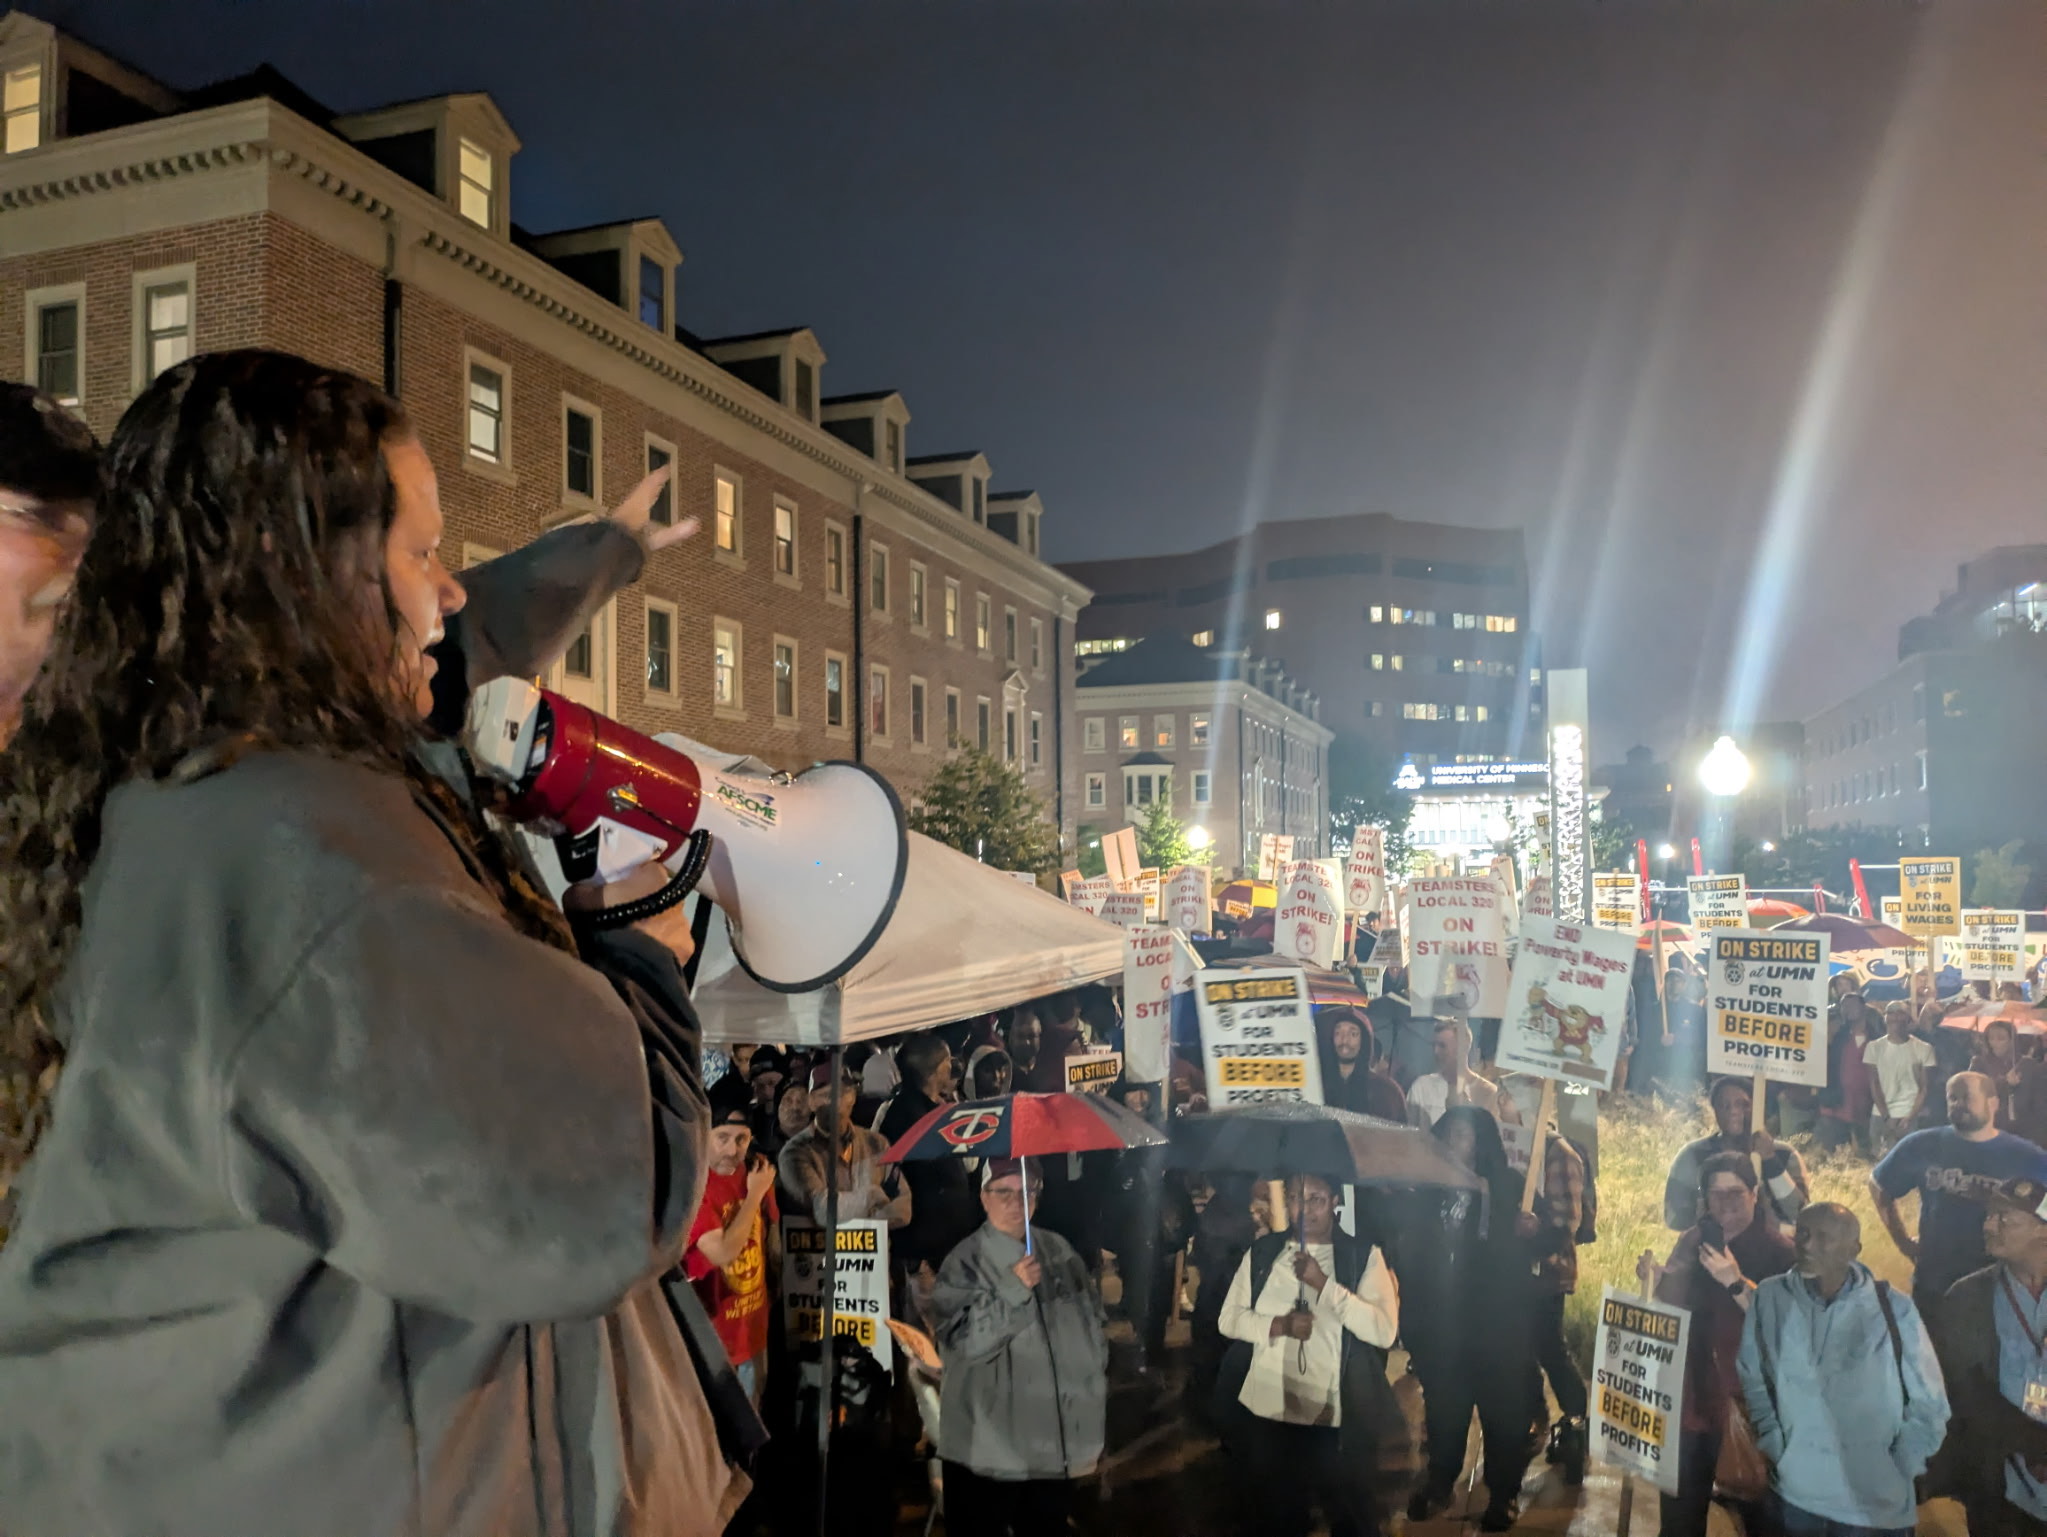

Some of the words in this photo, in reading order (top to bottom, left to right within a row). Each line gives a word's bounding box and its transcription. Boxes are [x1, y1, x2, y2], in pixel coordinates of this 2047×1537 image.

[1431, 765, 1488, 775] UNIVERSITY
[1489, 764, 1505, 774] OF
[1431, 775, 1475, 785] MEDICAL
[1476, 774, 1516, 784] CENTER
[717, 785, 777, 821] AFSCME
[1356, 851, 1375, 861] ON
[1905, 865, 1918, 875] ON
[1919, 863, 1953, 874] STRIKE
[1285, 873, 1314, 885] LOCAL
[1692, 882, 1704, 892] ON
[1705, 879, 1739, 890] STRIKE
[1412, 880, 1496, 894] TEAMSTERS
[1092, 892, 1109, 900] 320
[1297, 889, 1316, 903] ON
[1417, 897, 1468, 908] LOCAL
[1471, 896, 1495, 909] 320
[1915, 892, 1942, 900] FOR
[1120, 907, 1138, 915] 320
[1600, 910, 1632, 920] BEFORE
[1885, 903, 1900, 912] ON
[1907, 903, 1952, 913] LIVING
[1281, 906, 1333, 925] STRIKE!
[1906, 915, 1954, 924] WAGES
[1965, 915, 1980, 925] ON
[1982, 914, 2018, 925] STRIKE
[1442, 918, 1475, 933] ON
[1554, 924, 1582, 944] END
[1416, 940, 1499, 957] STRIKE!
[1719, 940, 1744, 957] ON
[1749, 941, 1817, 961] STRIKE
[1892, 949, 1929, 957] PROFIT
[1965, 943, 2019, 951] STUDENTS
[1523, 937, 1580, 966] Poverty
[1581, 949, 1629, 974] Wages
[1557, 969, 1574, 984] at
[1575, 971, 1607, 990] UMN
[1749, 966, 1766, 978] at
[1766, 966, 1816, 980] UMN
[1207, 984, 1233, 1001] ON
[1233, 979, 1297, 999] STRIKE
[1749, 984, 1783, 998] FOR
[1257, 1004, 1297, 1019] UMN
[1715, 996, 1818, 1019] STUDENTS
[1242, 1026, 1274, 1039] FOR
[1725, 1014, 1806, 1044] BEFORE
[1211, 1042, 1307, 1058] STUDENTS
[1724, 1040, 1806, 1062] PROFITS
[1070, 1067, 1083, 1082] ON
[1085, 1060, 1116, 1079] STRIKE
[1225, 1062, 1301, 1082] BEFORE
[815, 1231, 875, 1251] SRIKE
[818, 1279, 847, 1292] FR
[788, 1293, 880, 1313] STUENTS
[1605, 1303, 1623, 1324] ON
[1625, 1309, 1678, 1340] STRIKE
[1624, 1340, 1636, 1352] at
[1635, 1340, 1674, 1364] UMN
[1622, 1359, 1647, 1380] FOR
[1597, 1369, 1673, 1412] STUDENTS
[1602, 1391, 1663, 1440] BEFORE
[1601, 1422, 1662, 1462] PROFITS
